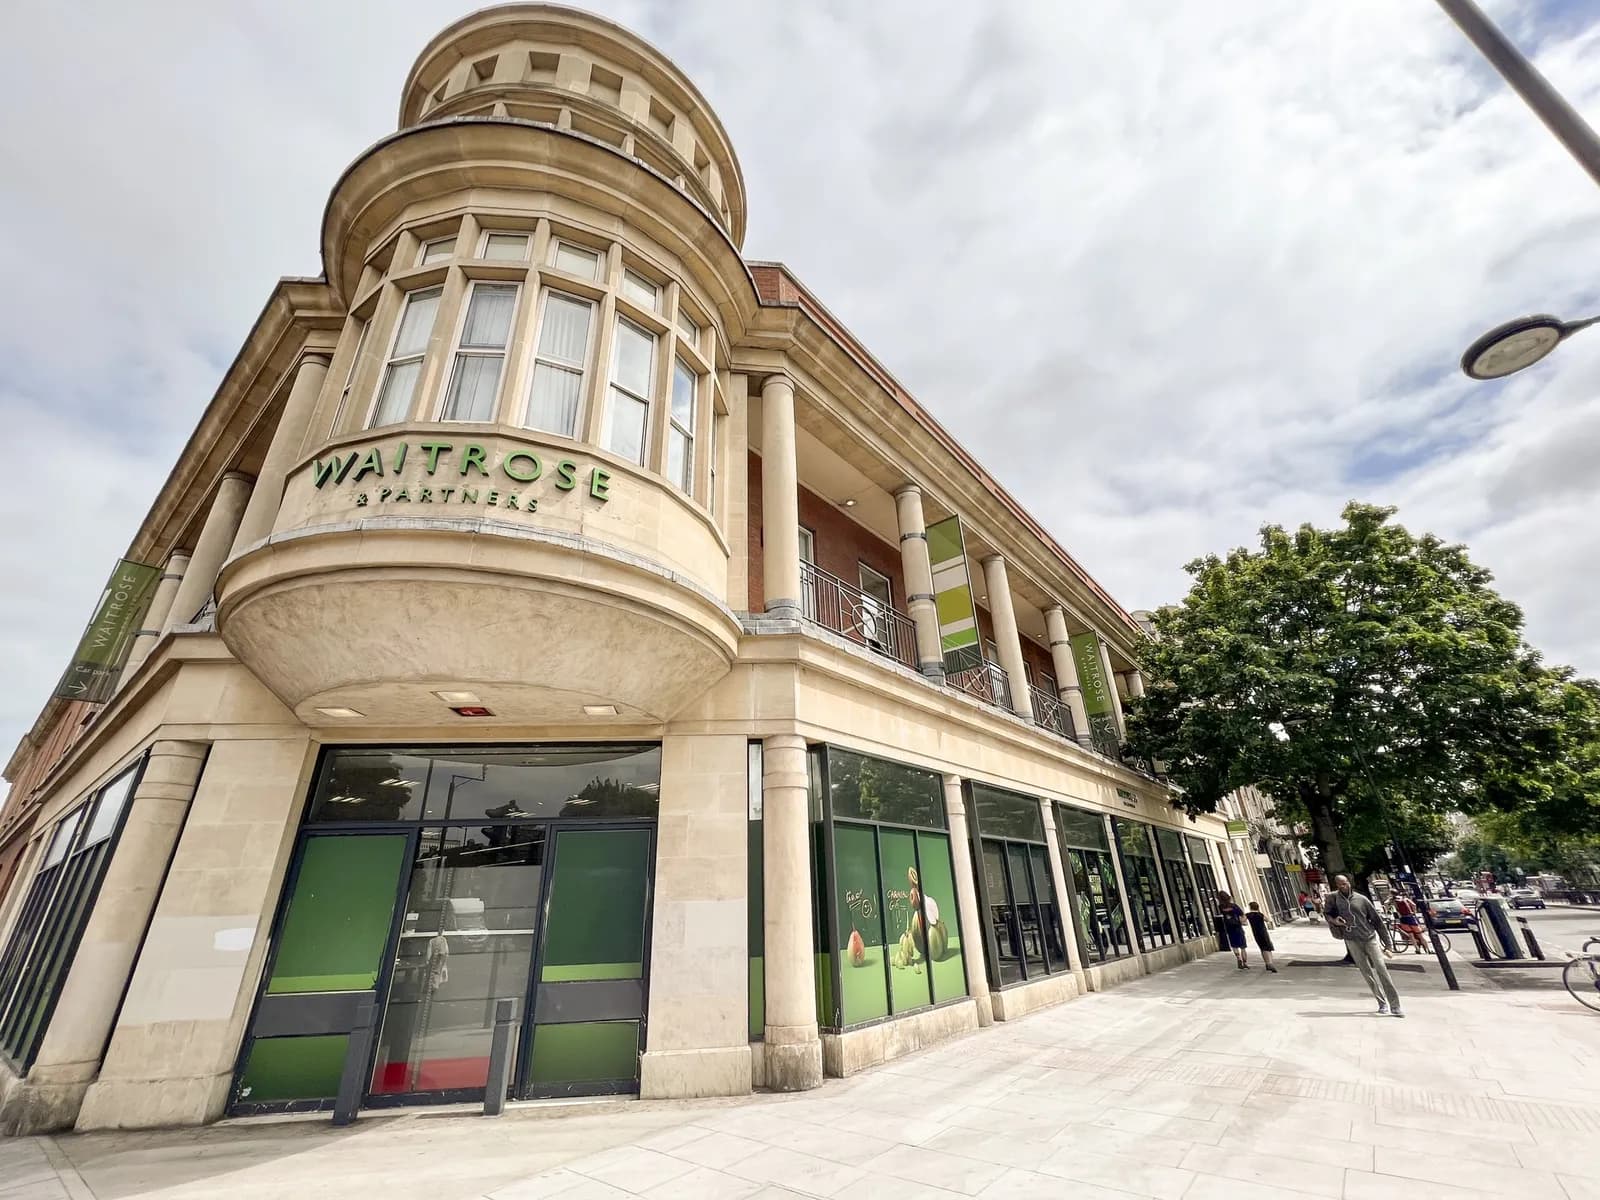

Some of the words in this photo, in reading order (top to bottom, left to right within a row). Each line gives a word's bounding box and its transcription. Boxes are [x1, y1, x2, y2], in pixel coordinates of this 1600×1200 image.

[313, 442, 611, 501] WAITROSE
[356, 492, 368, 506] &
[379, 487, 538, 512] PARTNERS
[91, 575, 136, 648] WAITROSE
[1084, 642, 1105, 702] WAITROSE
